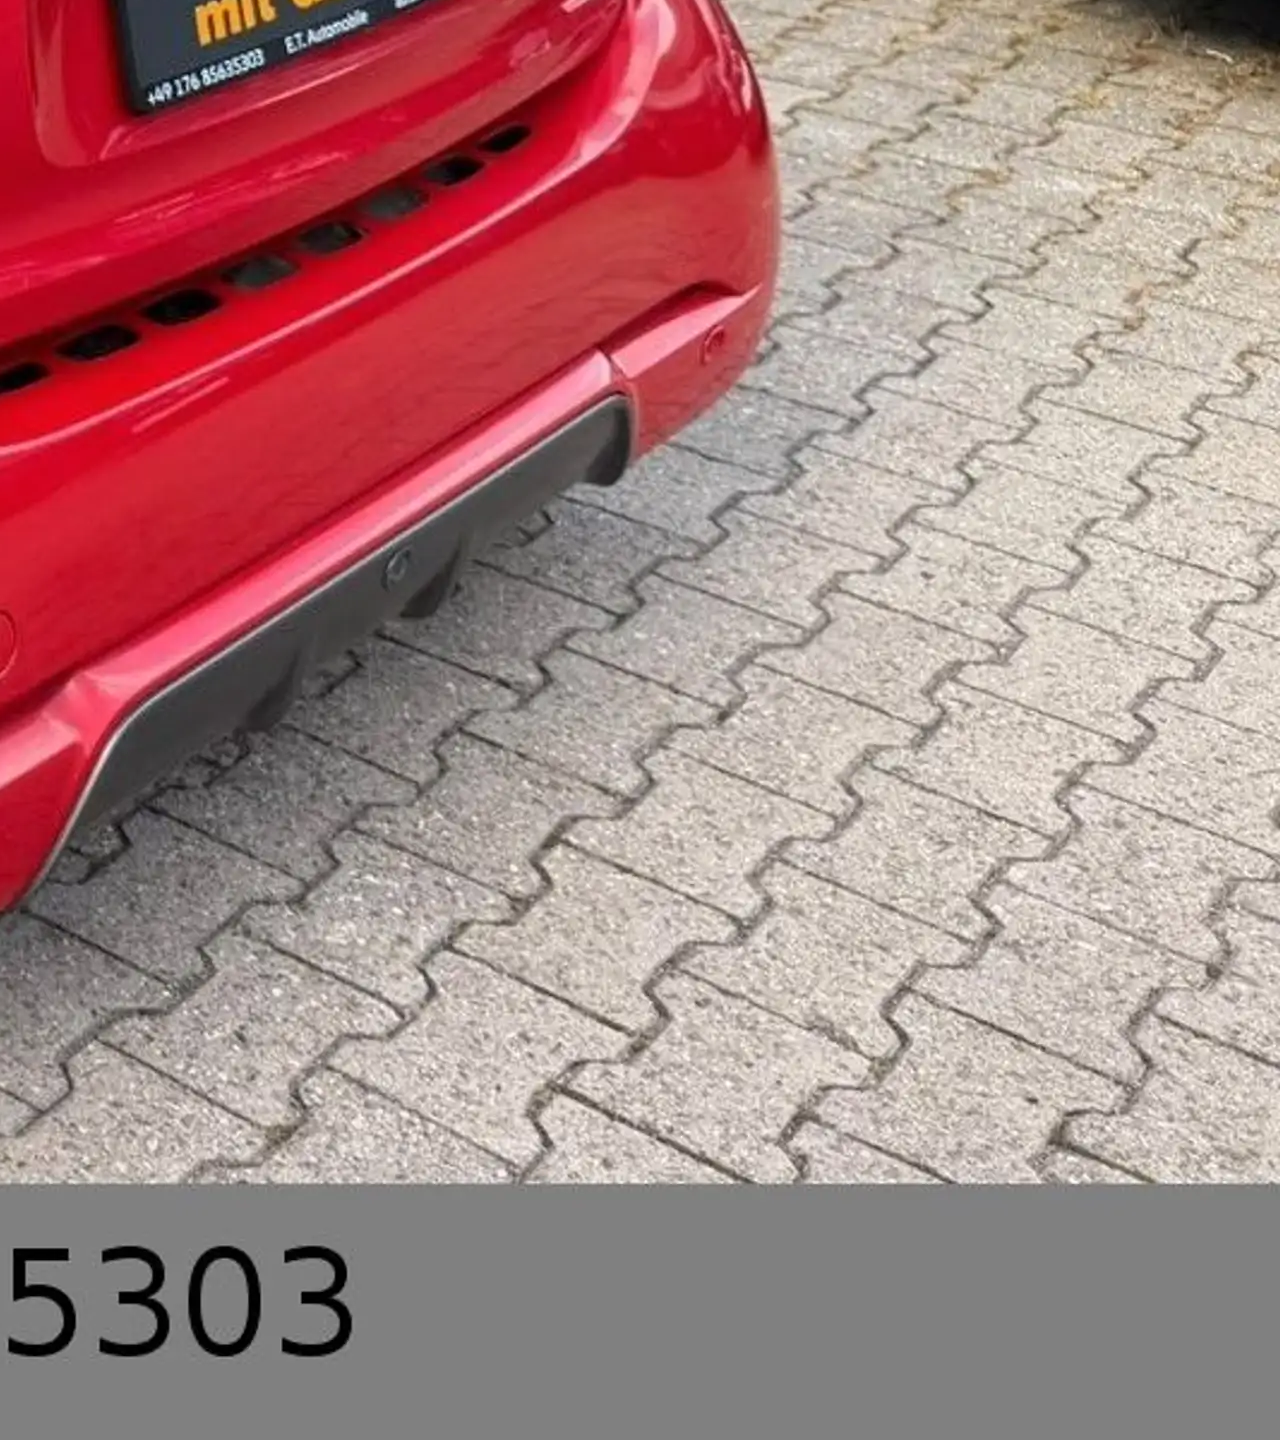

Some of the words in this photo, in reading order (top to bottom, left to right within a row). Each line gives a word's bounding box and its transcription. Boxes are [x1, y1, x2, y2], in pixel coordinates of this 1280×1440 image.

[147, 82, 173, 107] +49
[175, 73, 201, 97] 176
[201, 48, 266, 87] 85635303
